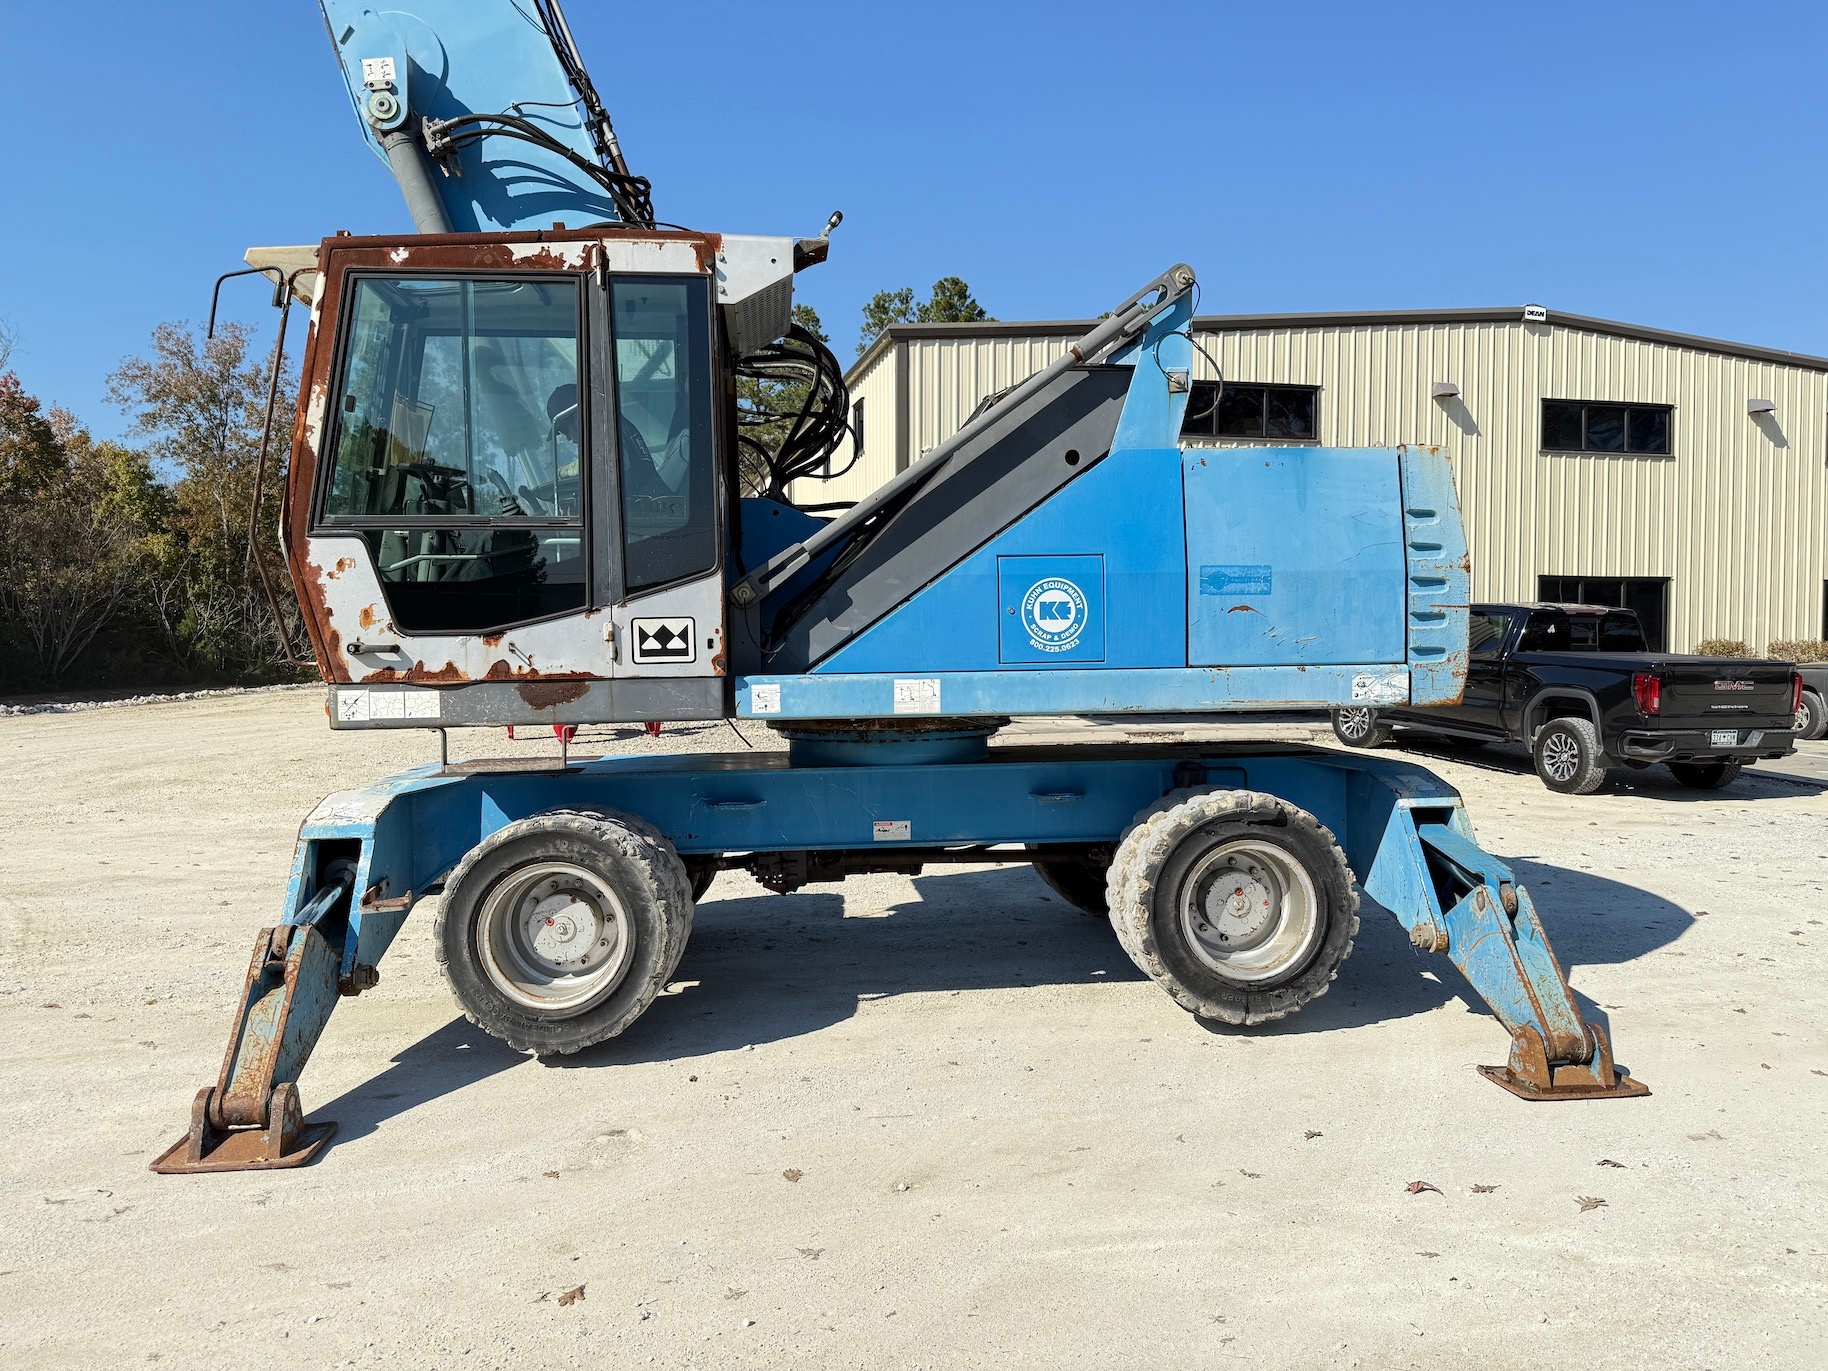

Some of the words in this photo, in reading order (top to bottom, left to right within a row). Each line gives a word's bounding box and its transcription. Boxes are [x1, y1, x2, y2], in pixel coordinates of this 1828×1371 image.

[1026, 587, 1043, 610] KUHN
[1043, 582, 1084, 609] EQUIPMENT
[1030, 623, 1052, 640] SCRAP
[1061, 623, 1079, 639] DEMO
[1714, 680, 1755, 691] GMC
